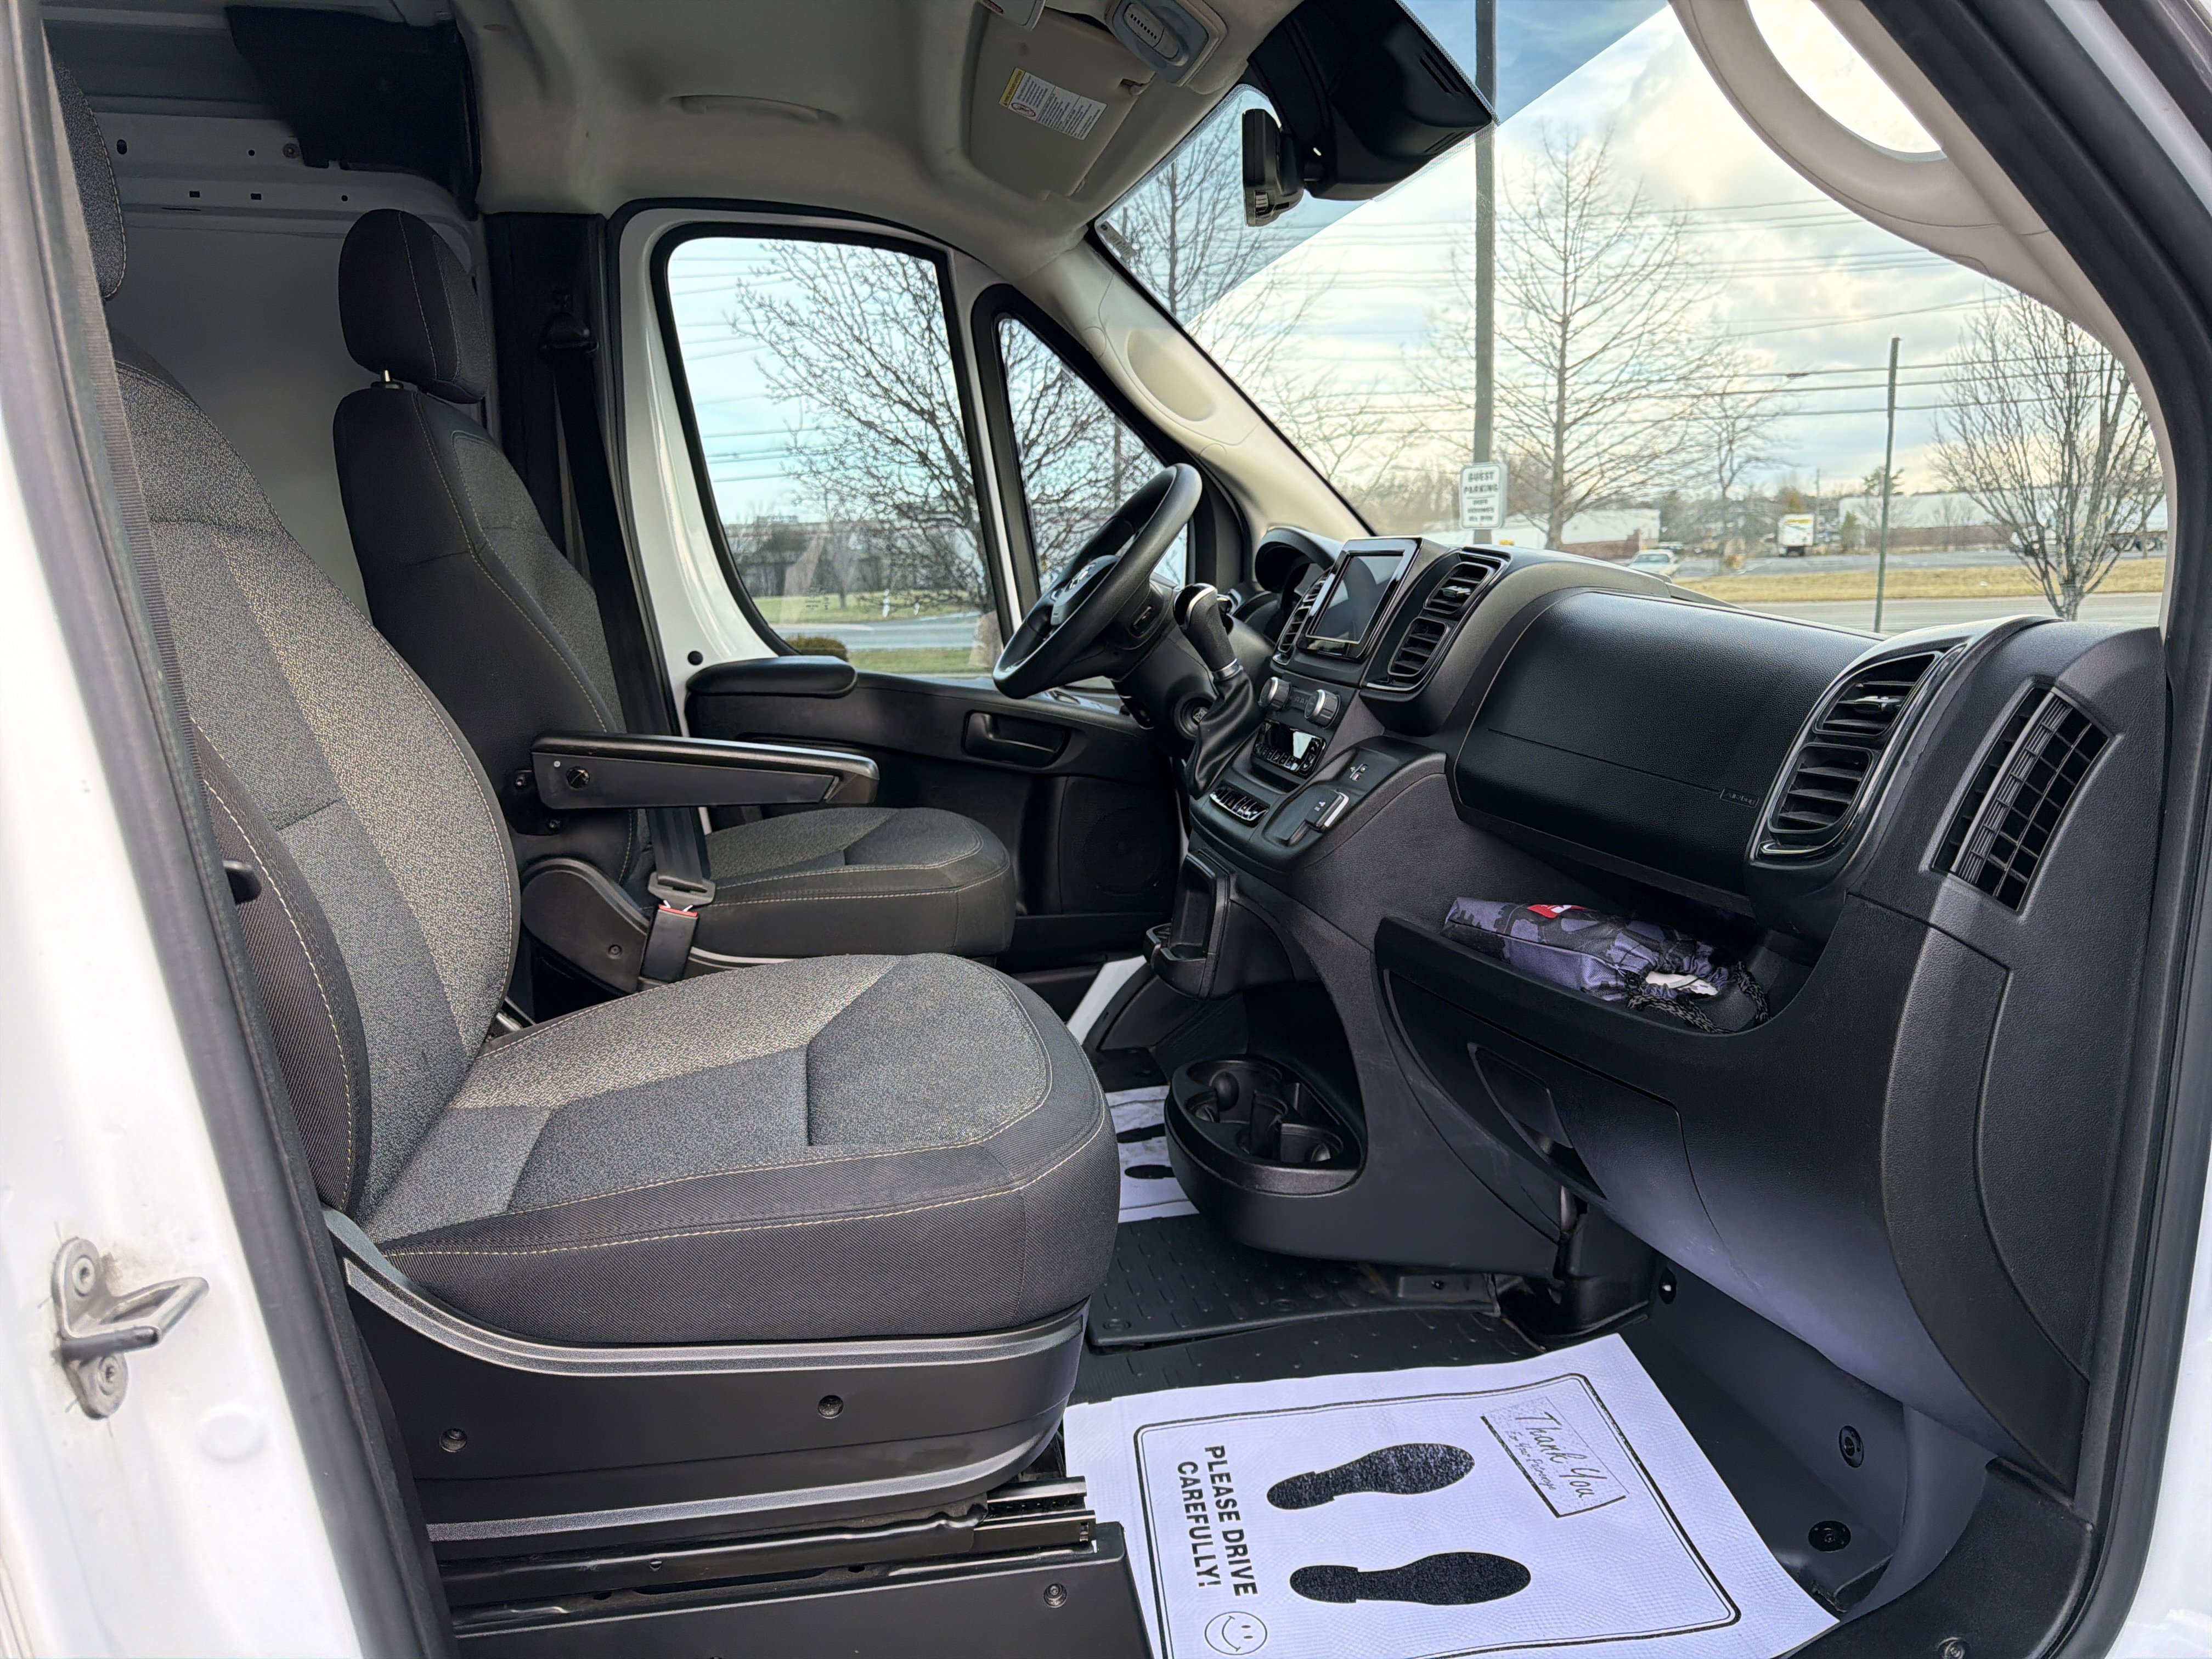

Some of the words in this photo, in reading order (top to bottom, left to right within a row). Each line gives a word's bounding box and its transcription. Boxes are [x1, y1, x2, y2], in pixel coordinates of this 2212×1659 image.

[1463, 484, 1499, 494] PARKING
[1468, 472, 1494, 482] GUEST
[1294, 696, 1308, 704] RA
[1204, 1445, 1241, 1522] PLEASE
[1515, 1412, 1587, 1464] Thank
[1559, 1468, 1607, 1498] You
[1177, 1461, 1222, 1587] CAREFULLY!
[1222, 1529, 1258, 1596] DRIVE
